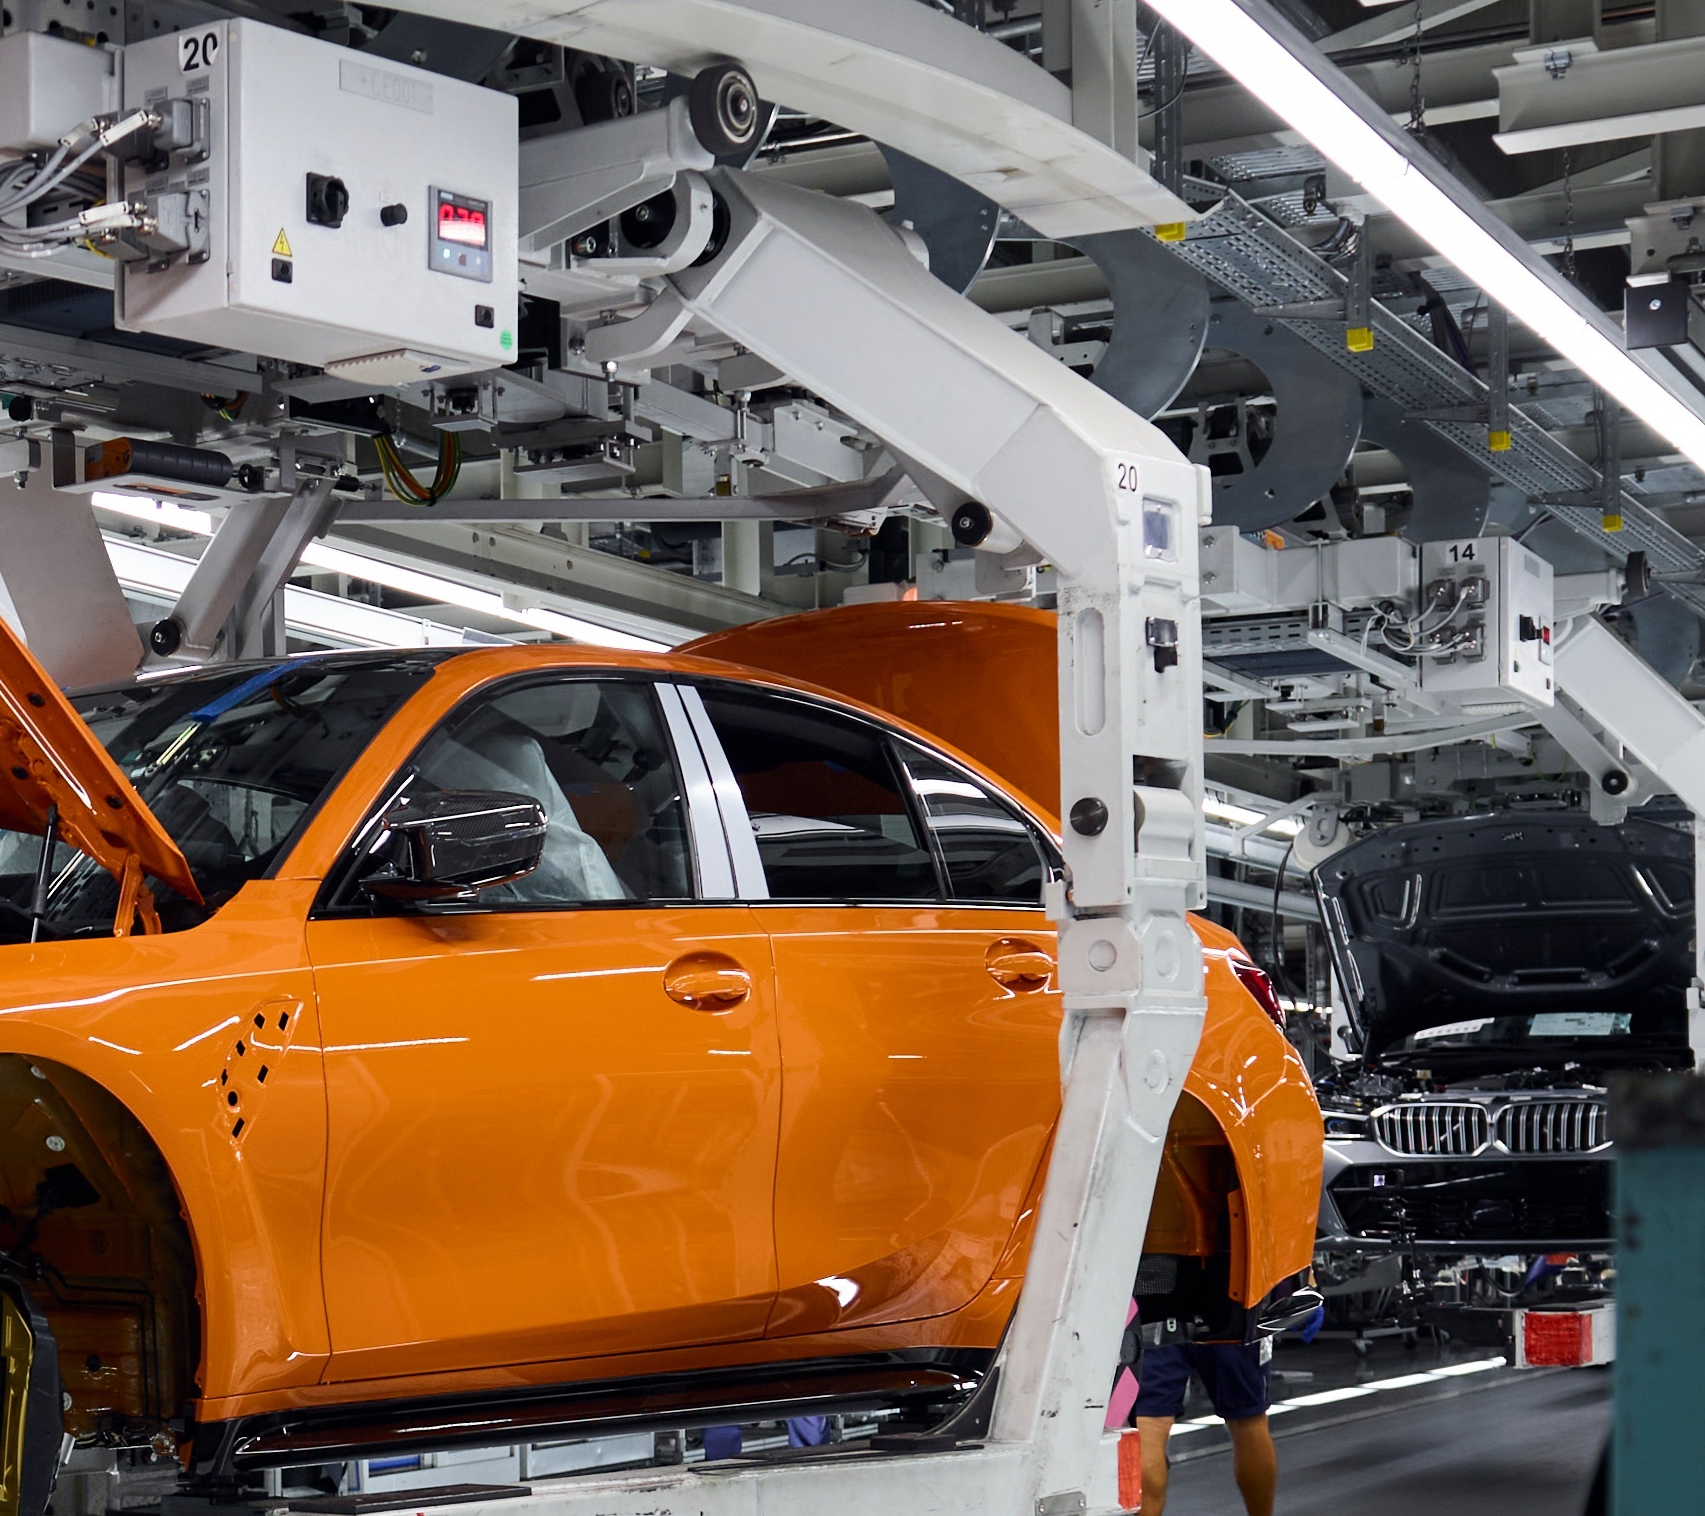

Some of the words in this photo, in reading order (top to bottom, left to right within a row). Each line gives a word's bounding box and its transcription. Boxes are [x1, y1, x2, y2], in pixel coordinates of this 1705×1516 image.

[183, 32, 218, 72] 20
[1118, 462, 1138, 492] 20
[1449, 543, 1476, 562] 14
